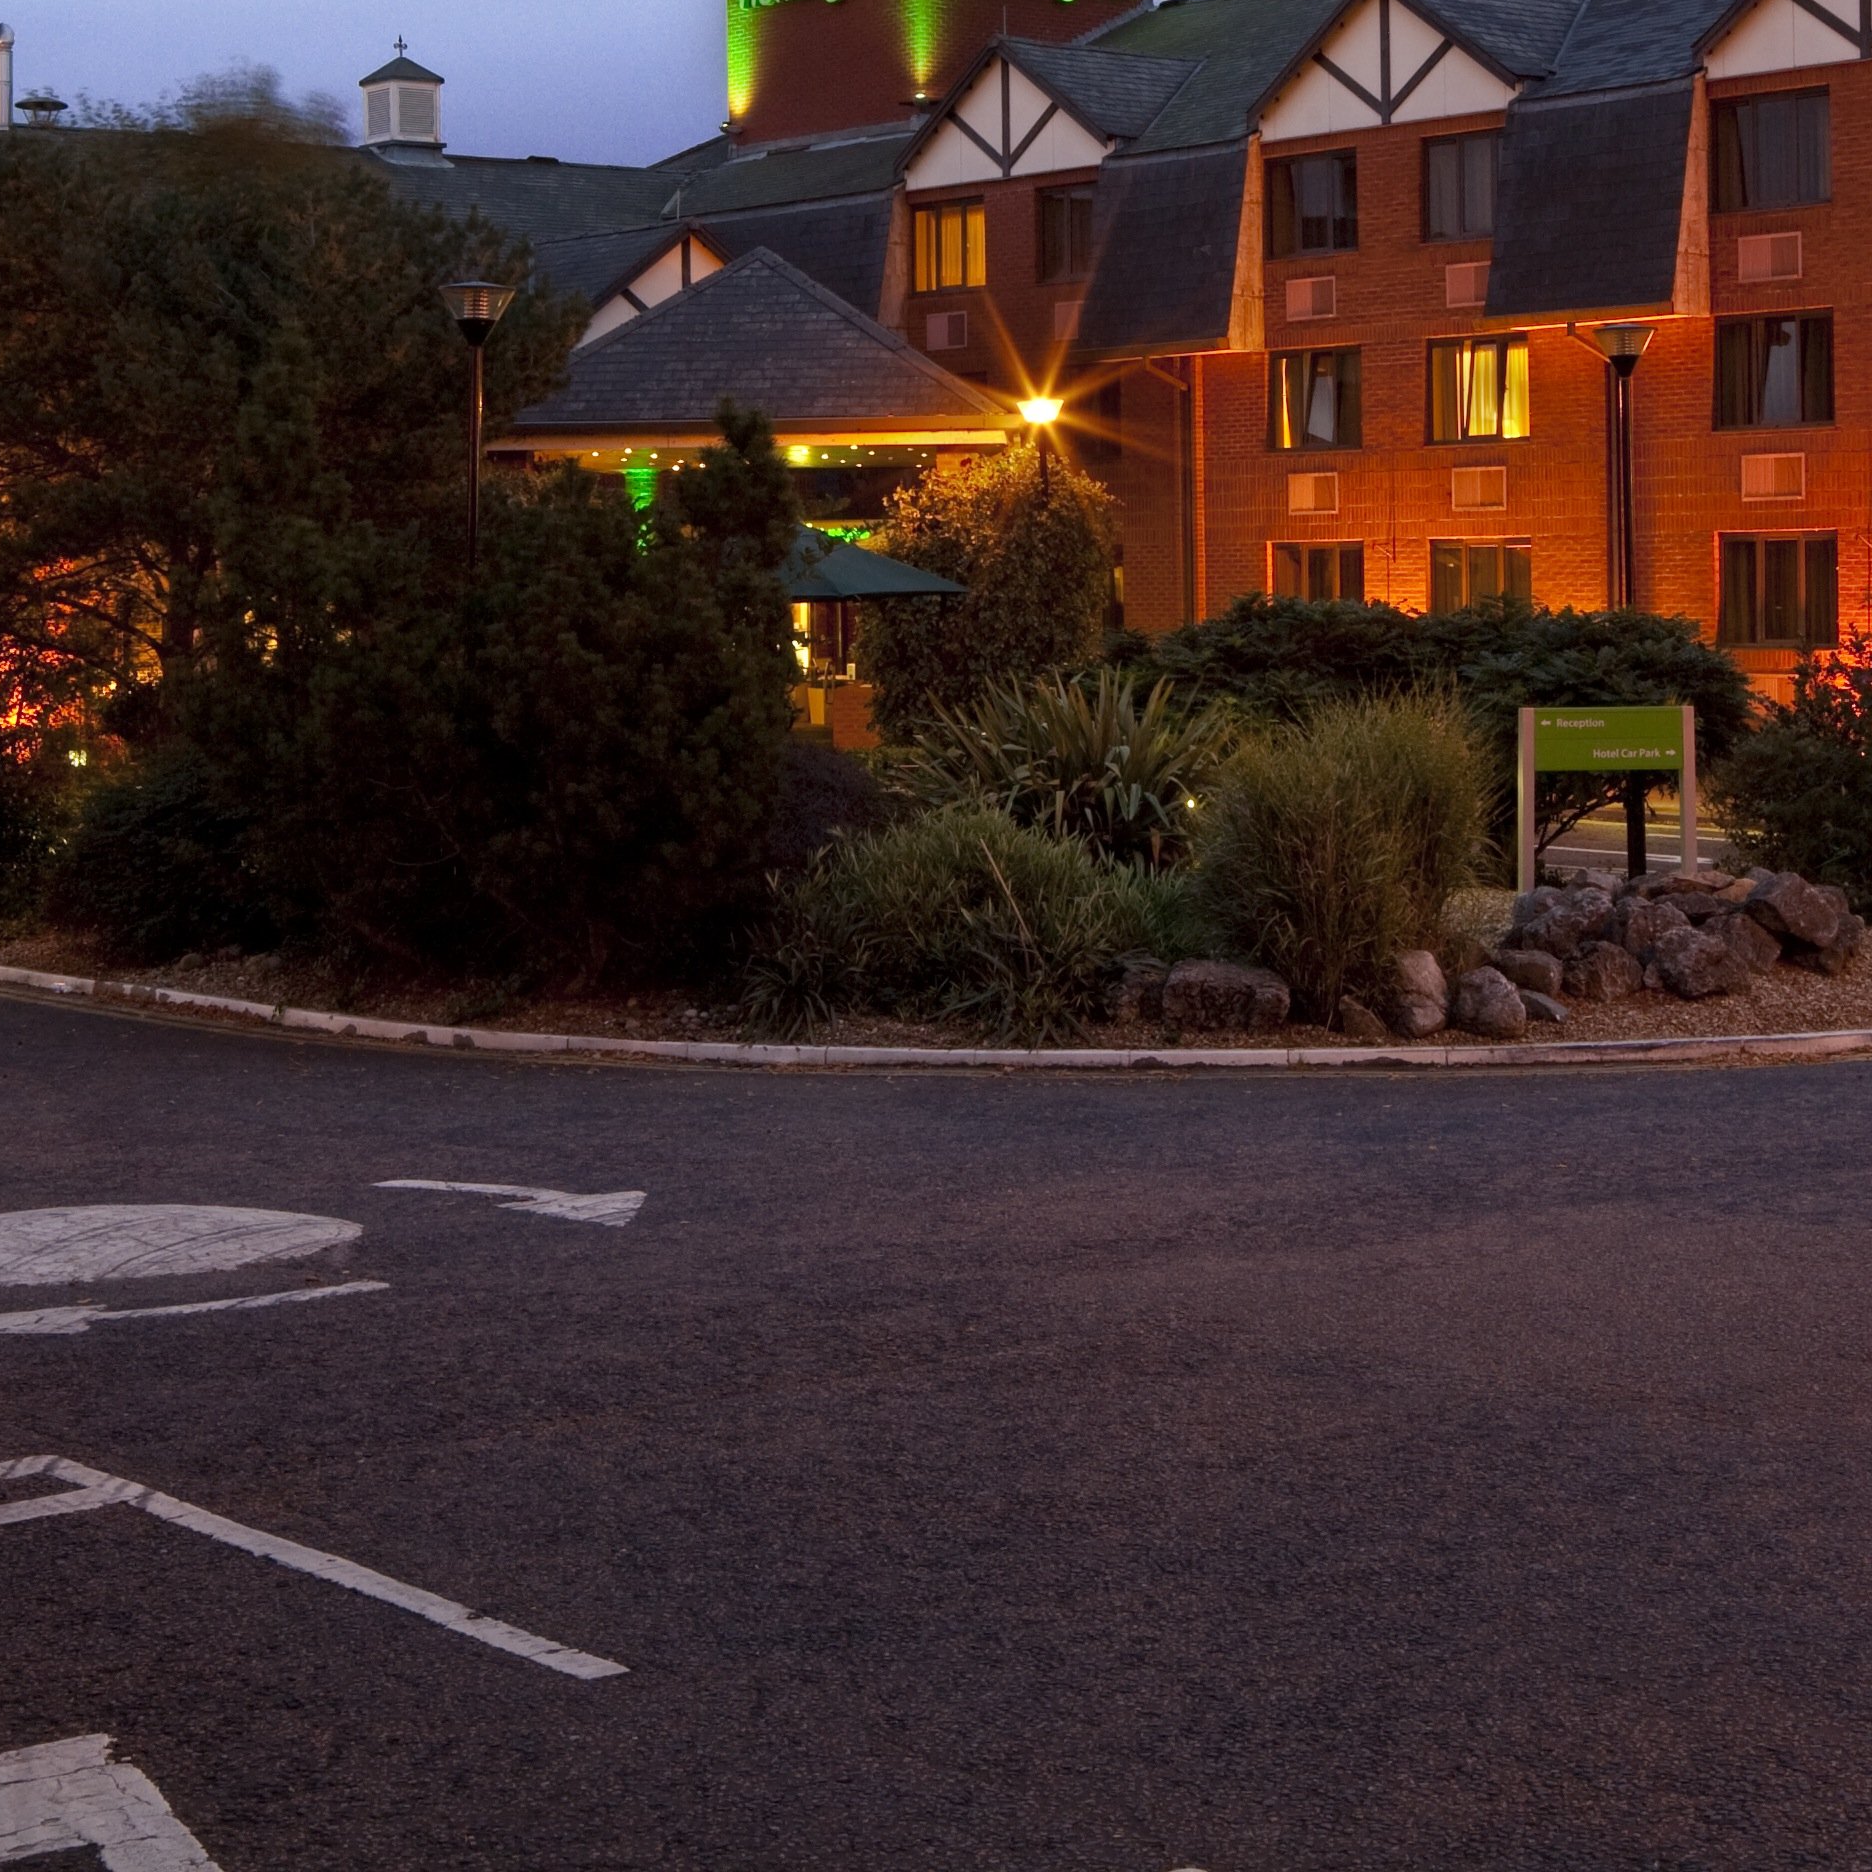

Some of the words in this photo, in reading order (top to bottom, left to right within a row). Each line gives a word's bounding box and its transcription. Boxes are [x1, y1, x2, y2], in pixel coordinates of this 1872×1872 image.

[1556, 718, 1605, 729] Reception
[1592, 748, 1619, 759] Hotel
[1620, 748, 1638, 759] Car
[1639, 748, 1661, 759] Park
